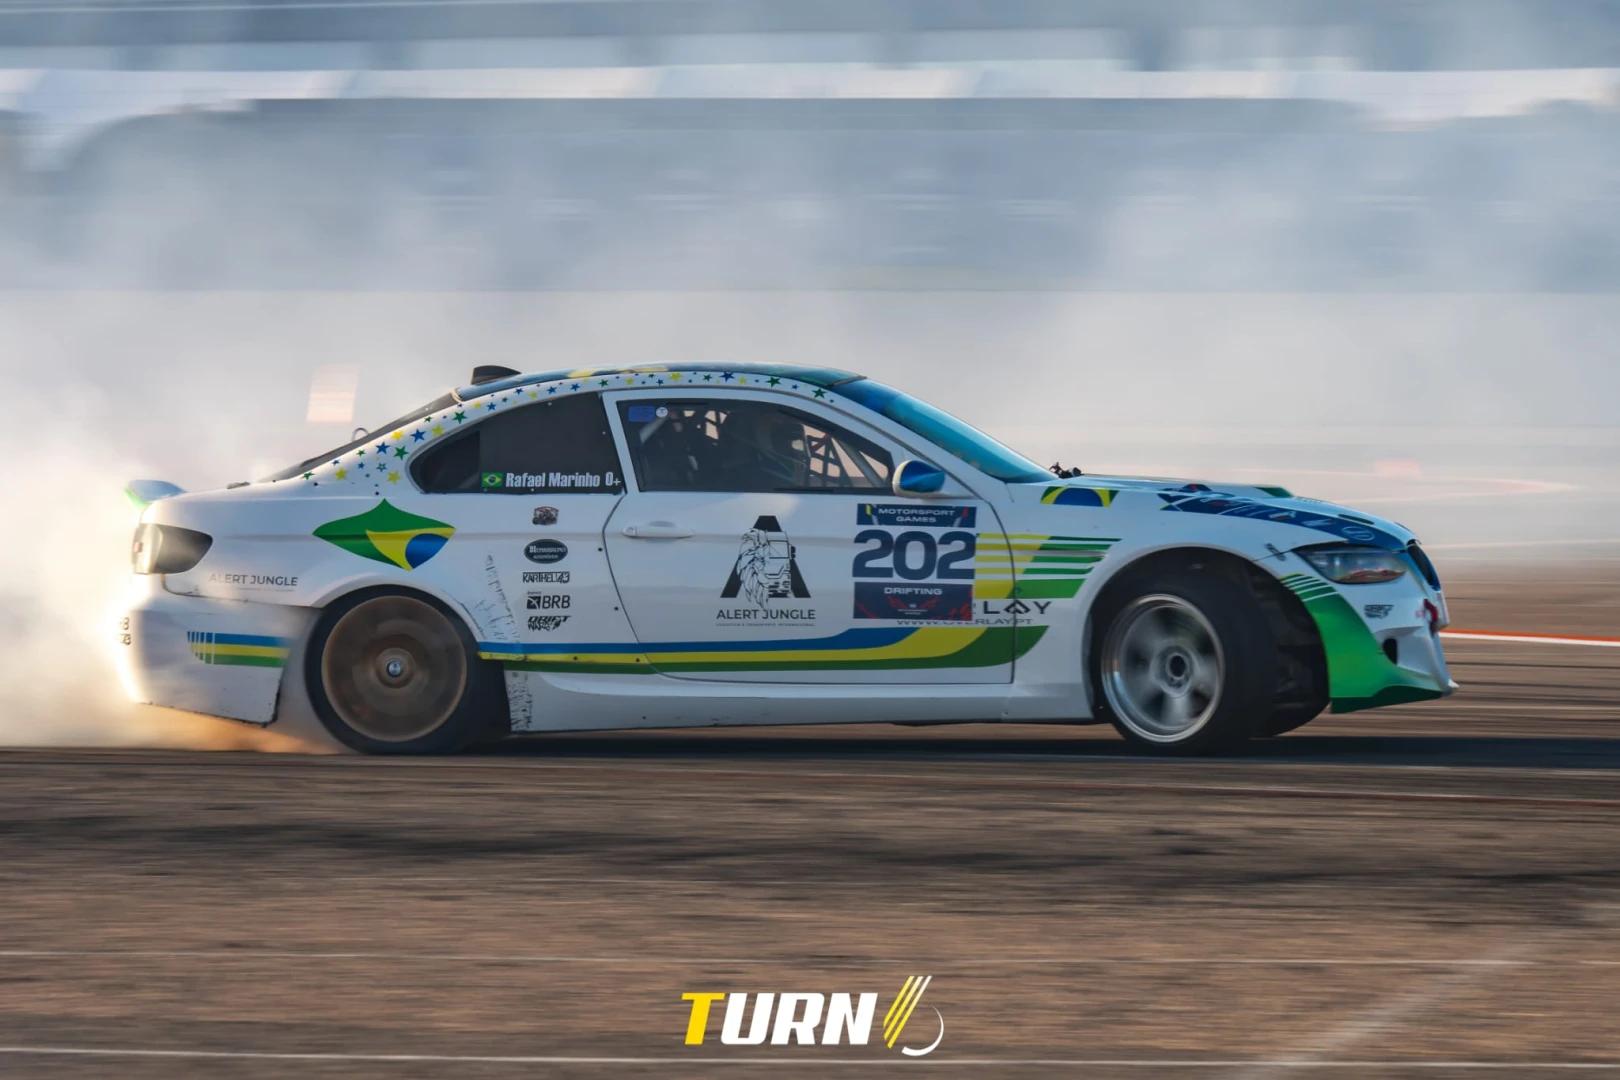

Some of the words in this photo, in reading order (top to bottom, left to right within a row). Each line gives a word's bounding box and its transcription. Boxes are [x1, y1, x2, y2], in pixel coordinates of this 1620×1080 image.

[505, 472, 545, 487] Rafael
[548, 472, 600, 487] Marinho
[878, 508, 955, 516] MOTORSPORT
[852, 529, 976, 580] 202
[208, 573, 248, 585] ALERT
[249, 575, 299, 587] JUNGLE
[884, 587, 943, 596] DRIFTING
[542, 595, 571, 609] BRB
[716, 609, 760, 620] ALERT
[762, 609, 817, 620] JUNGLE
